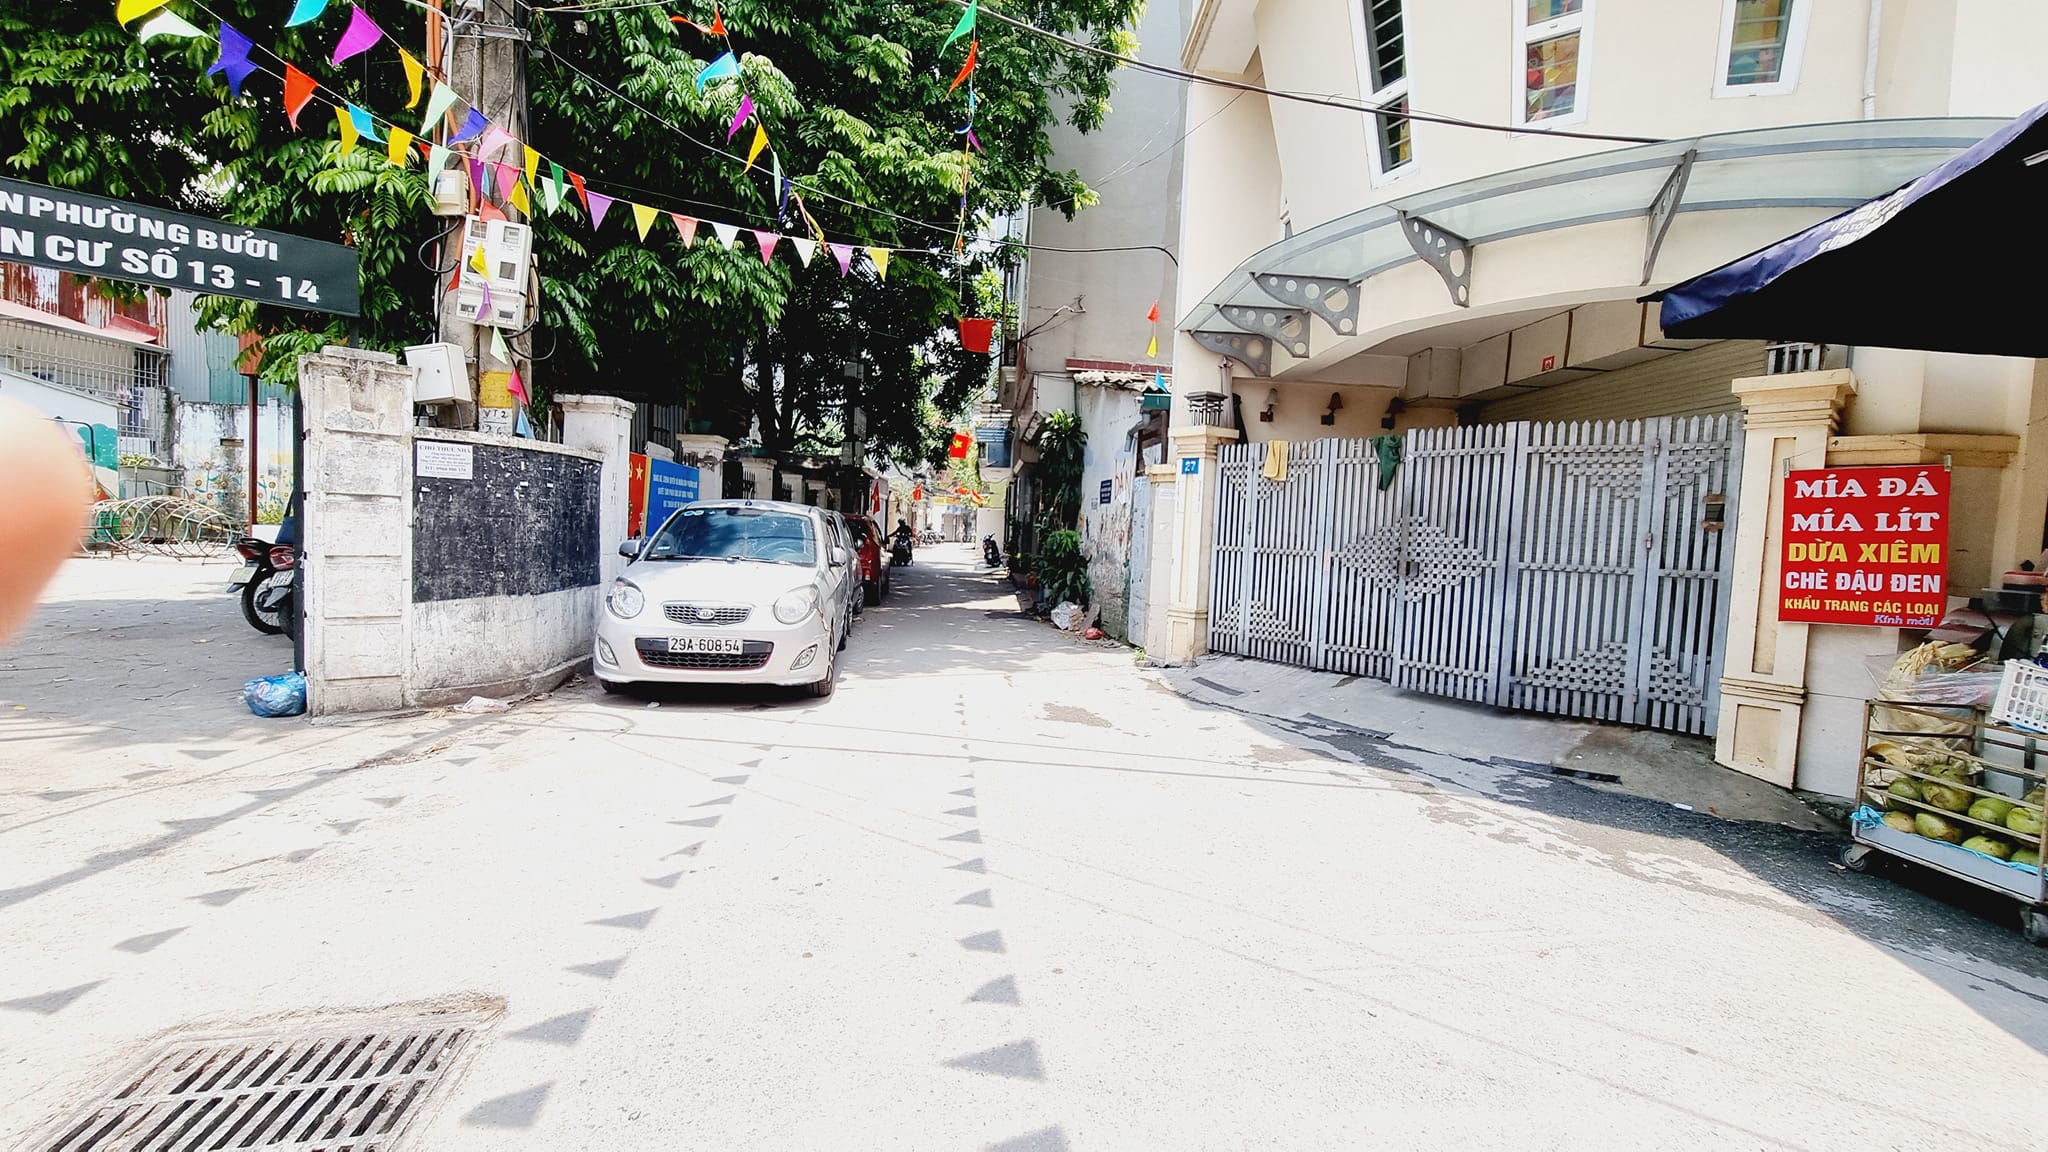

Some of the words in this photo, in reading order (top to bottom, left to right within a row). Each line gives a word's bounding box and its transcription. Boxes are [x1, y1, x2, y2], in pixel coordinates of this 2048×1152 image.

[29, 195, 190, 245] PHƯỜNG
[197, 229, 278, 262] BƯỞI
[45, 234, 113, 267] CƯ
[121, 246, 180, 279] SỐ
[187, 260, 235, 289] 13
[275, 276, 320, 303] 14
[1184, 461, 1197, 472] 27
[1794, 473, 1868, 499] MÍA
[1877, 471, 1939, 498] ĐÁ
[1790, 507, 1865, 532] MÍA
[1874, 506, 1941, 532] LÍT
[1788, 538, 1848, 563] DỪA
[1857, 539, 1941, 565] XIÊM
[1785, 569, 1829, 591] CHÈ
[1835, 569, 1883, 595] ĐẬU
[1890, 574, 1941, 594] ĐEN
[1784, 595, 1821, 610] KHẨU
[1824, 599, 1870, 613] TRANG
[1873, 600, 1902, 614] CÁC
[1906, 602, 1939, 618] LOẠI
[1874, 614, 1904, 625] Kính
